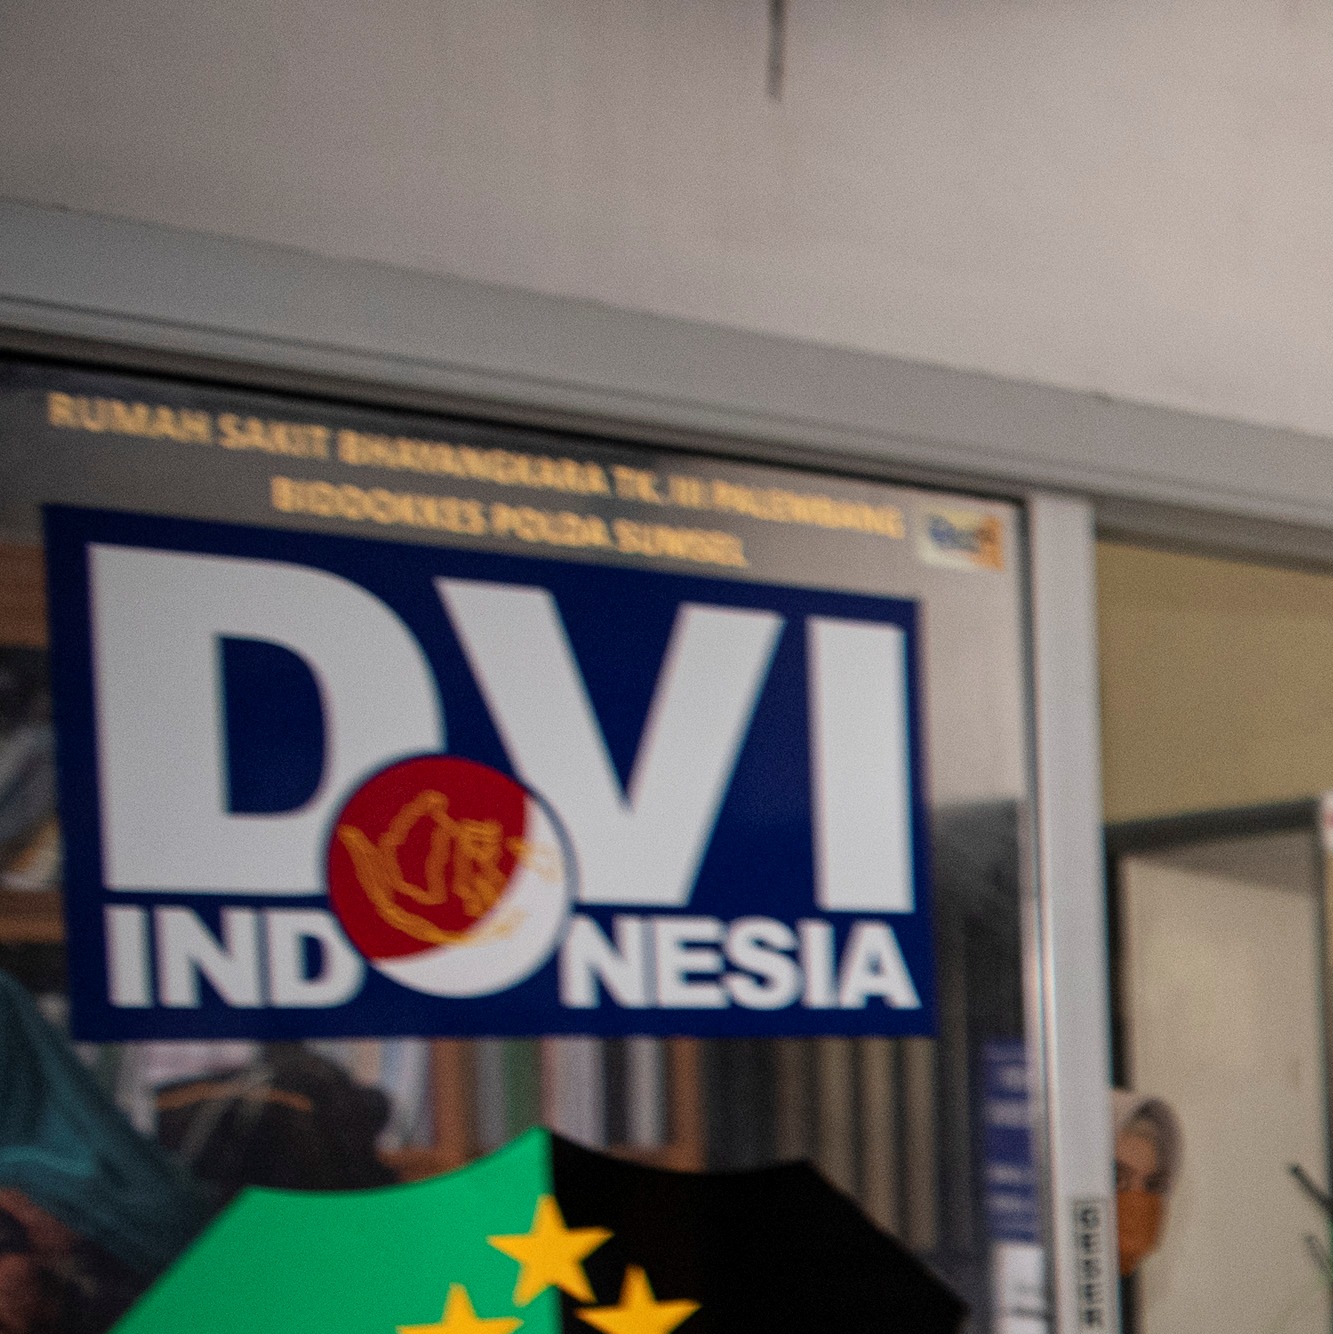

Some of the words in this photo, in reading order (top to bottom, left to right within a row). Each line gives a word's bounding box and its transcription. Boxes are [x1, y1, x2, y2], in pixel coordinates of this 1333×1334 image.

[48, 391, 211, 444] RUMAH
[217, 411, 332, 460] SAKIT
[336, 427, 611, 497] BHAYANGKARA
[710, 477, 905, 540] PALEMBANG
[489, 501, 614, 550] POLDA
[87, 540, 917, 914] DVI
